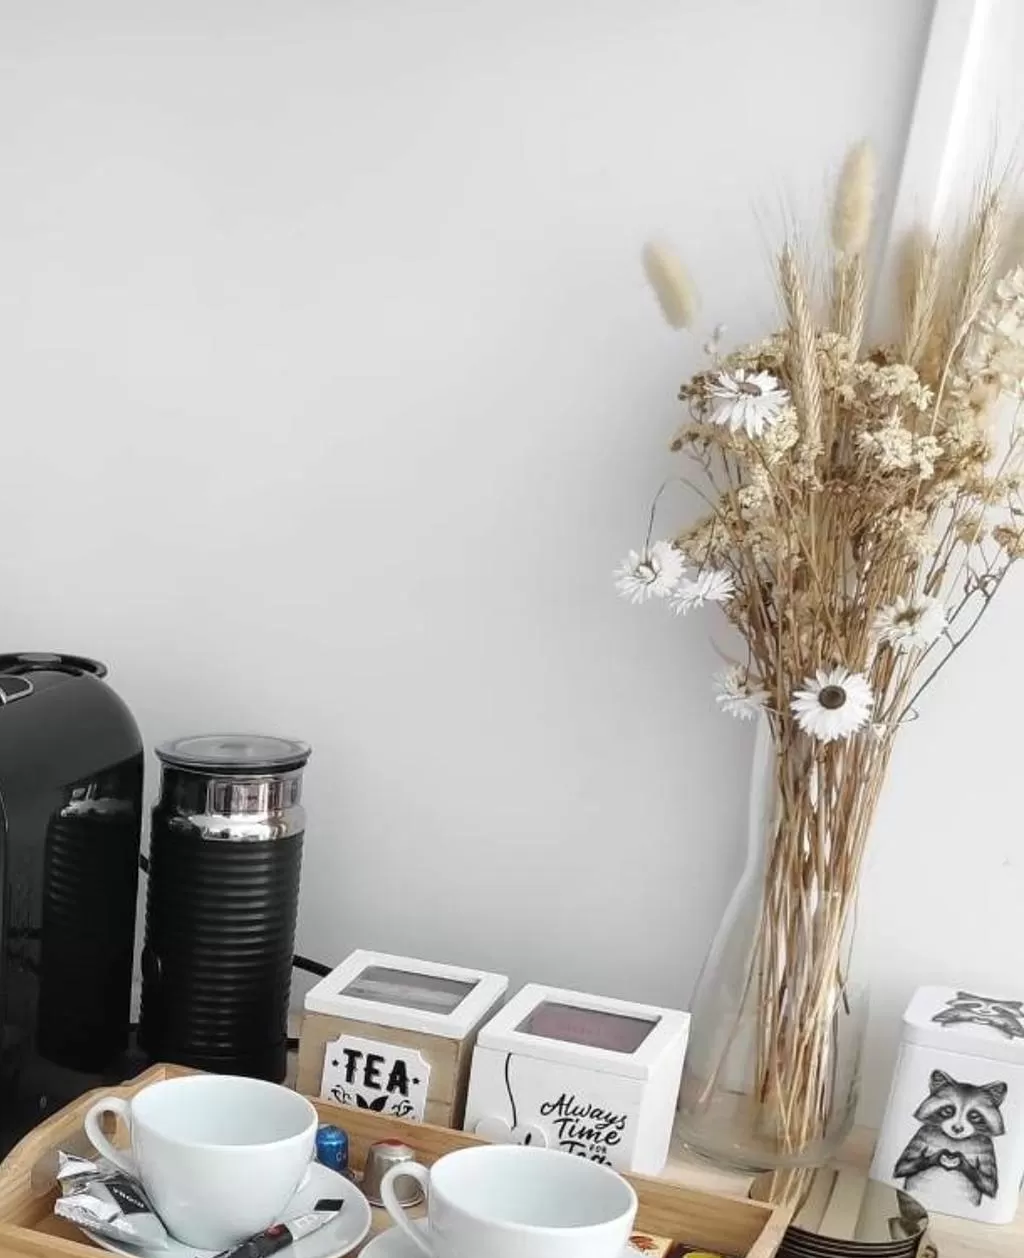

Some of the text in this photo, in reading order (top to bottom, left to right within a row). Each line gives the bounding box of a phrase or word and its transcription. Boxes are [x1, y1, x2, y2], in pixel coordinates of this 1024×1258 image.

[342, 1048, 409, 1098] TEA
[540, 1093, 628, 1130] Always
[552, 1117, 621, 1146] Time
